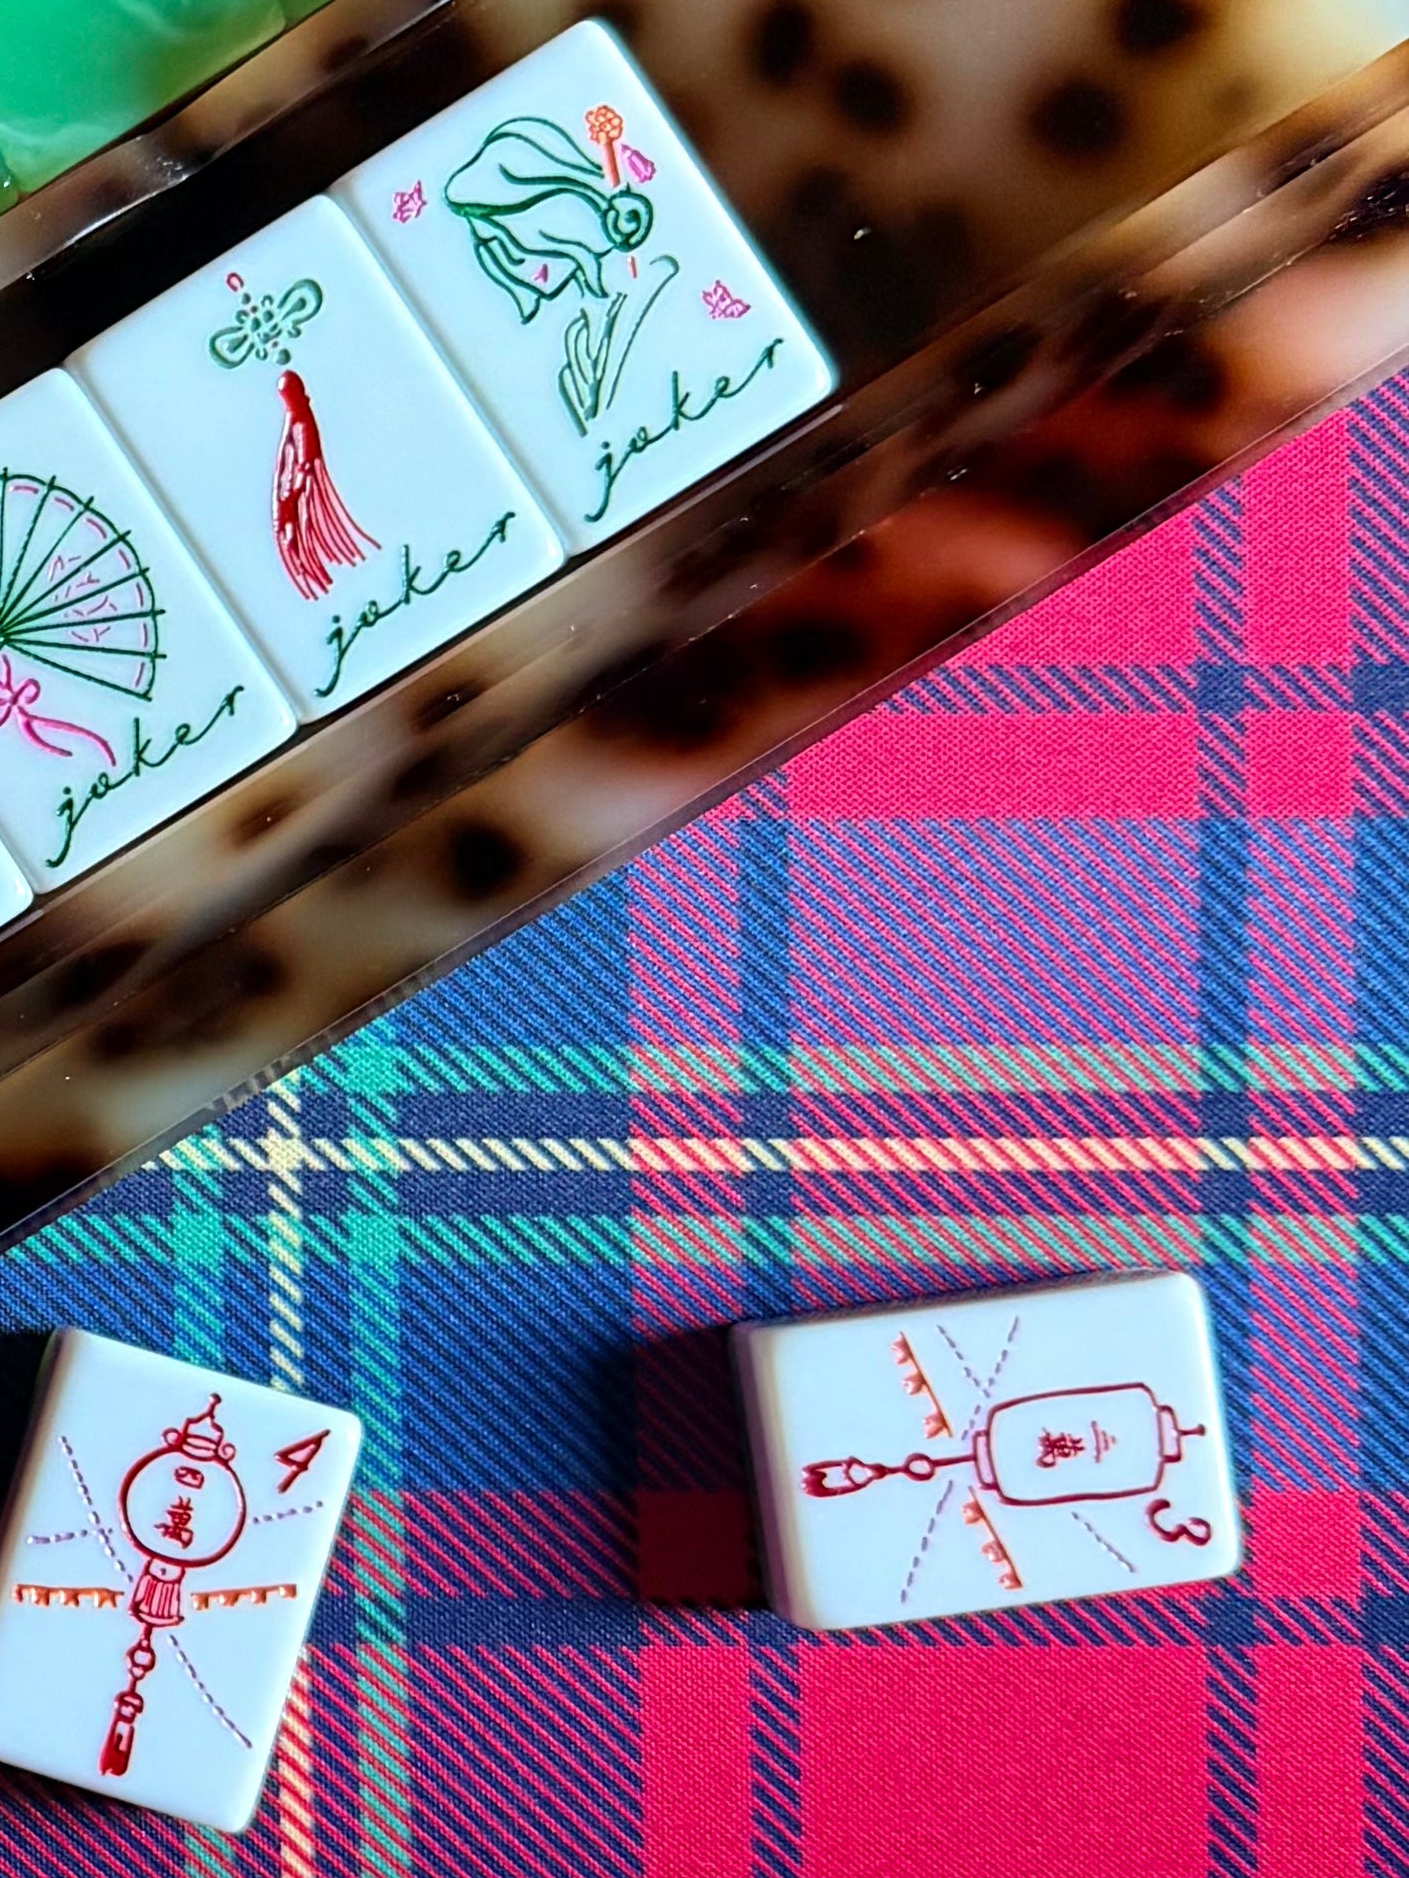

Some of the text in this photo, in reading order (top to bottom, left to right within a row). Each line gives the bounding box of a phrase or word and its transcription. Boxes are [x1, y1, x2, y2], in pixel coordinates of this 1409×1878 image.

[584, 338, 785, 523] joker
[313, 510, 517, 698] joker
[45, 685, 246, 868] joker
[274, 1429, 331, 1494] 4
[1145, 1498, 1213, 1547] 3
